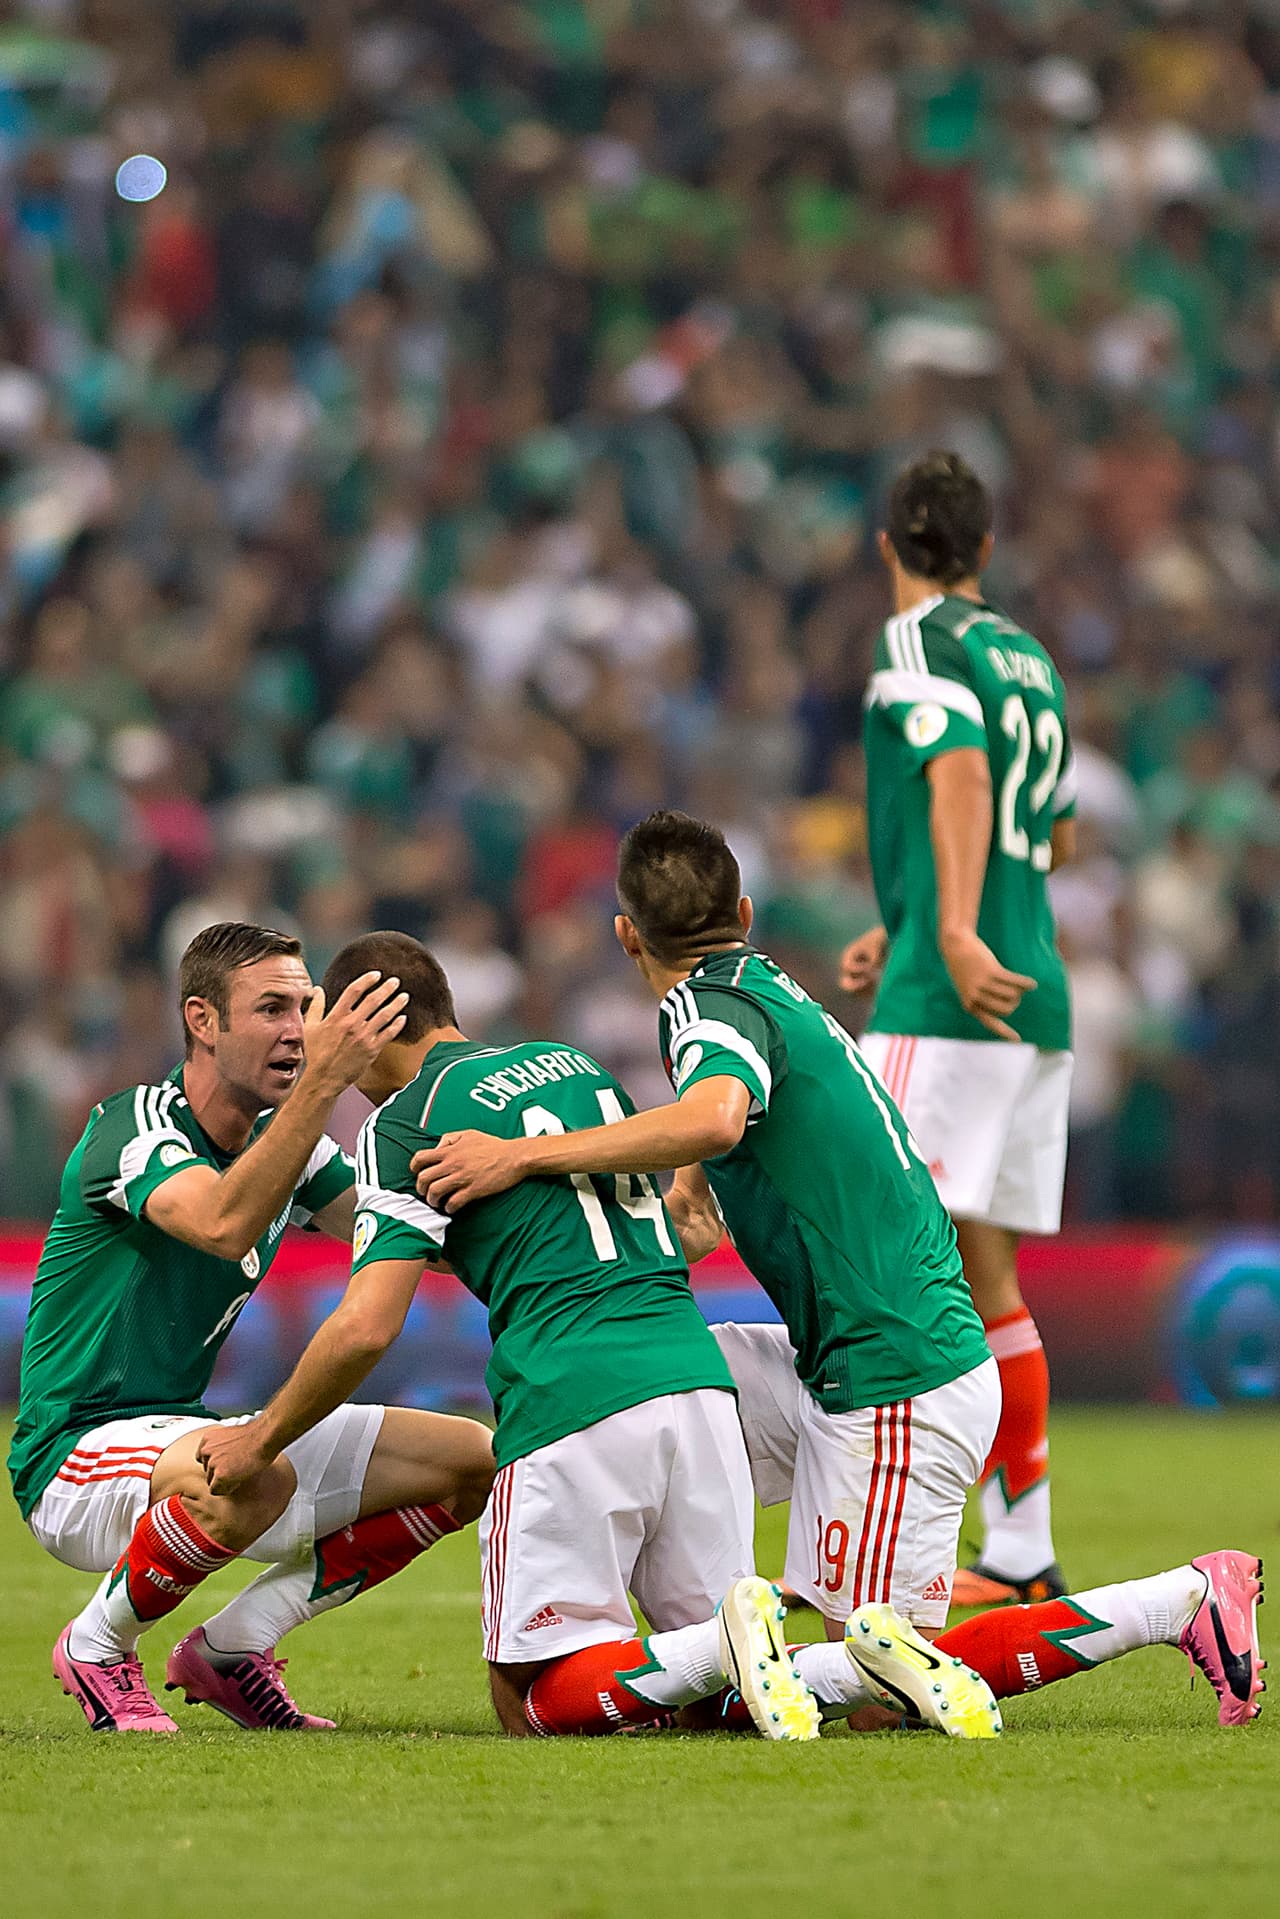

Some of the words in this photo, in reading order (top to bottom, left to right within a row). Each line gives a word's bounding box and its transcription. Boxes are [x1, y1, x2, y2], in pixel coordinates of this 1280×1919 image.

[469, 1050, 600, 1112] CHICHARITO
[813, 1514, 849, 1592] 19
[921, 1591, 950, 1601] adida
[523, 1614, 564, 1633] adidas
